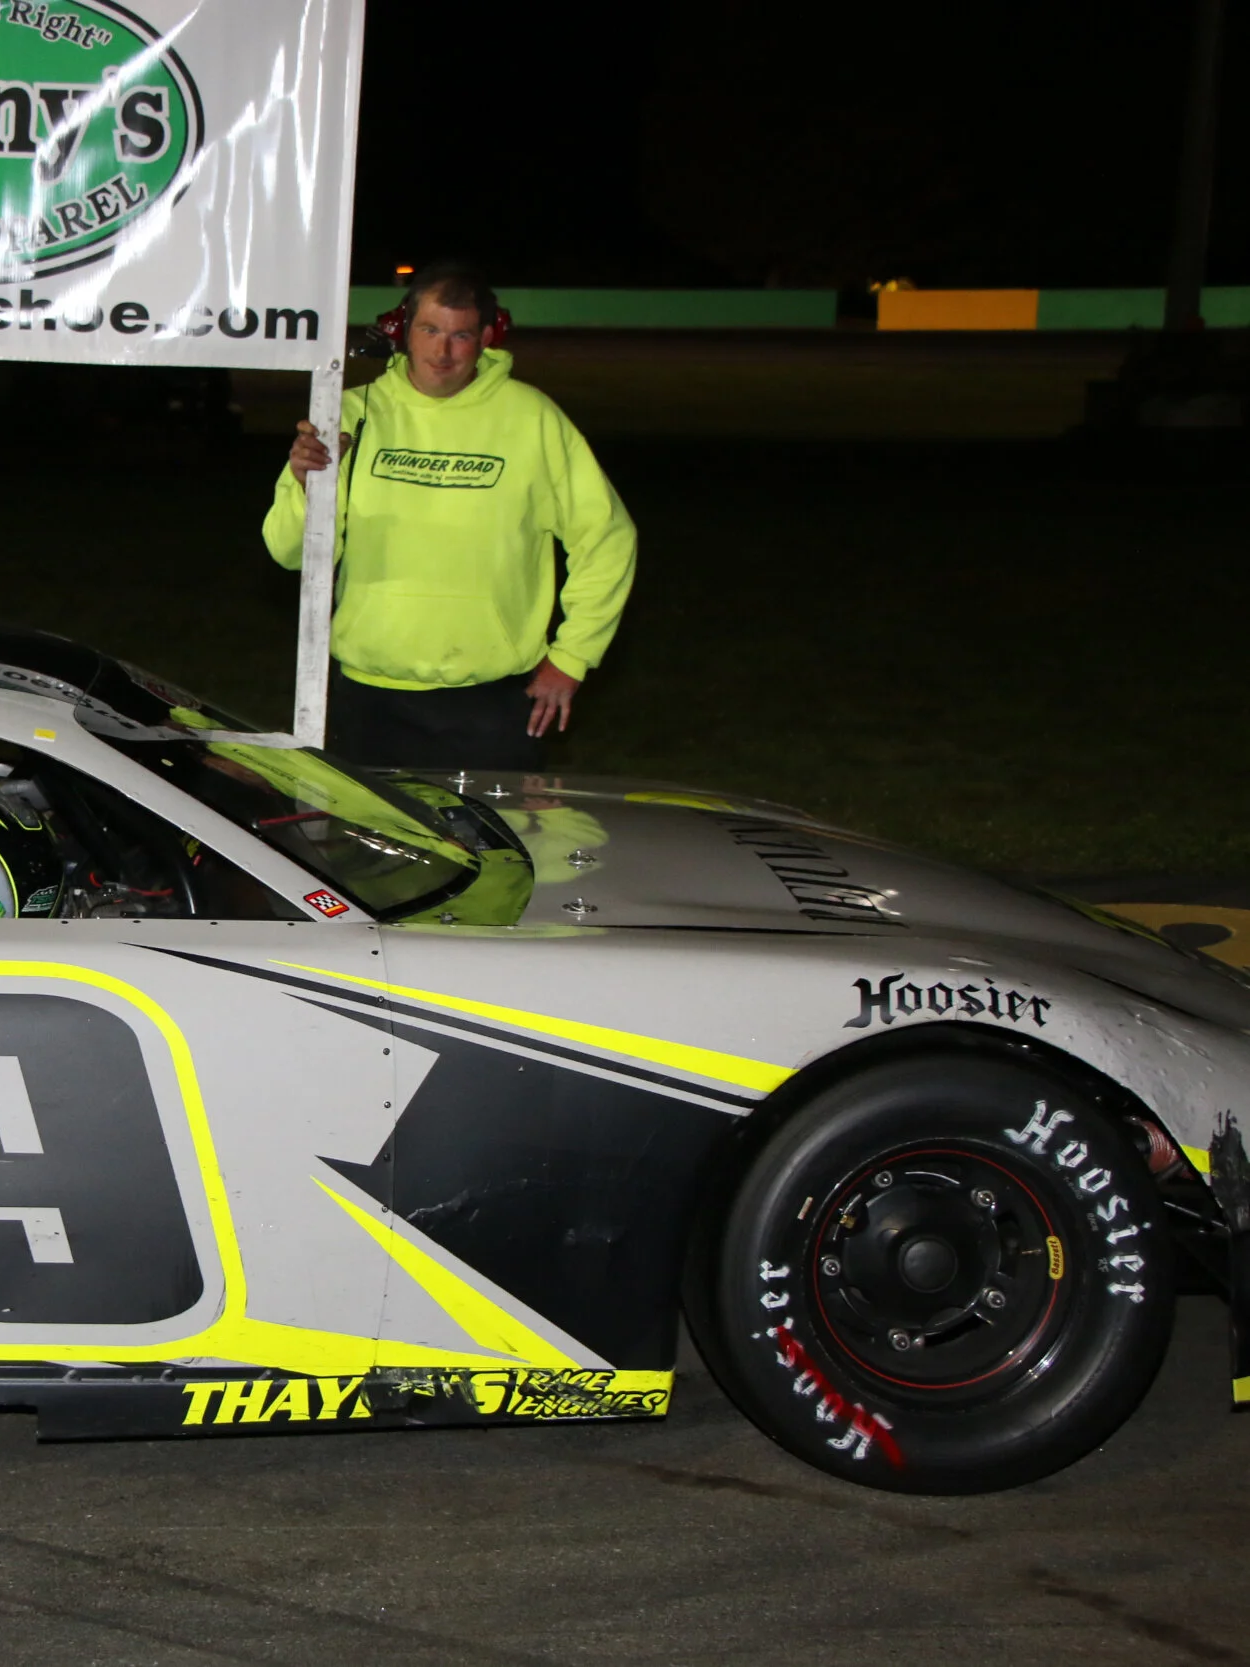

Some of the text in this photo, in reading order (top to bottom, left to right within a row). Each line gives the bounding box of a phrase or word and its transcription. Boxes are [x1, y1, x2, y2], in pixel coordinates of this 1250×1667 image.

[380, 453, 495, 473] THUNDER ROAD
[843, 973, 1052, 1028] Hoosier
[1004, 1099, 1152, 1304] Hoosier
[1048, 1239, 1060, 1276] Bassett
